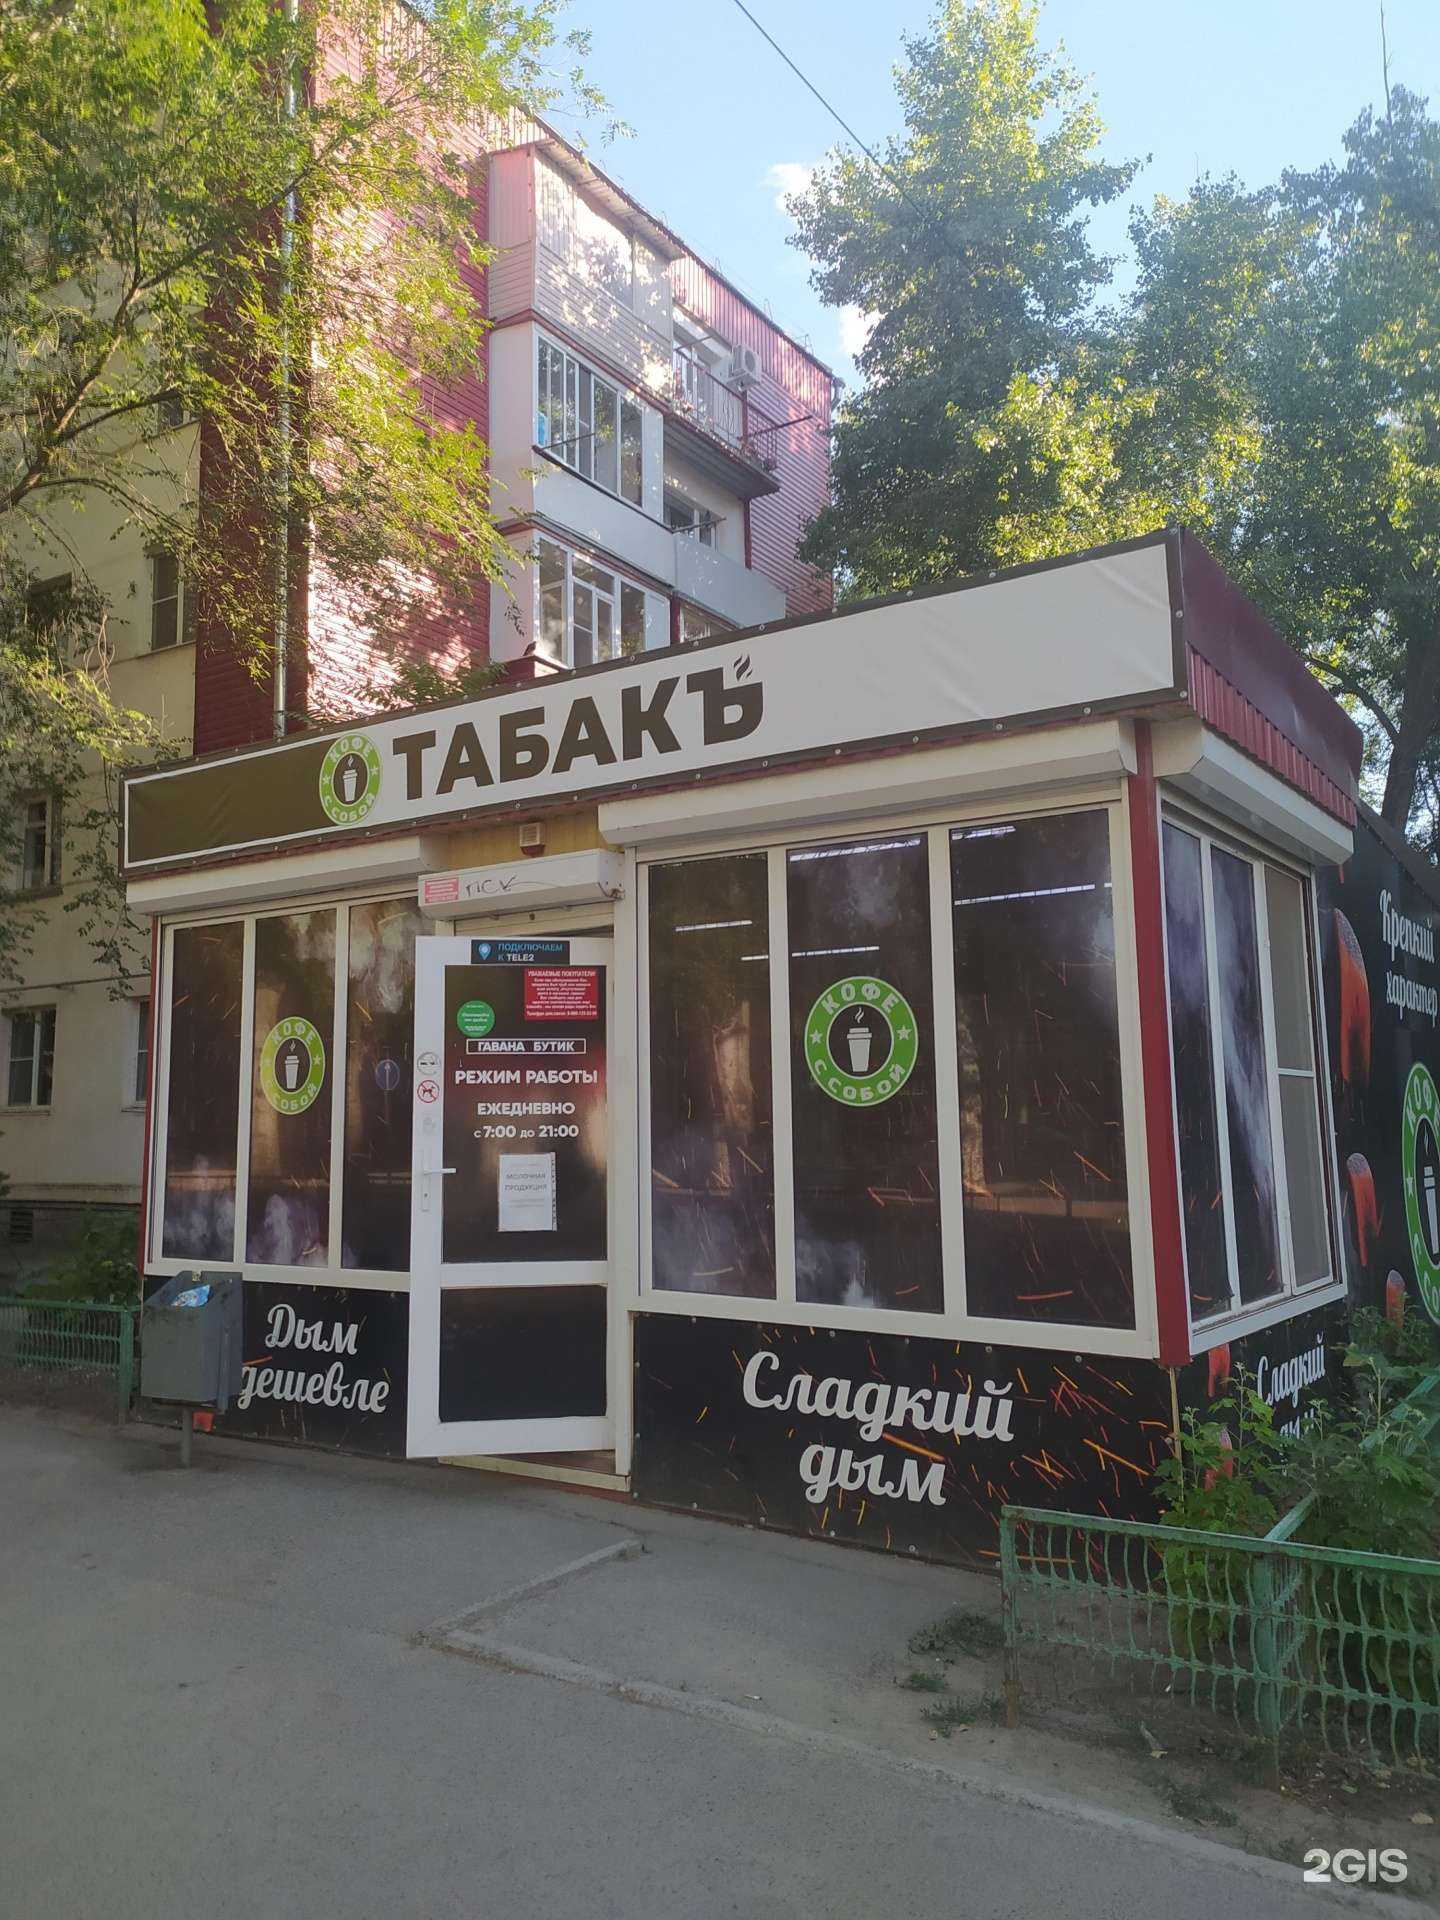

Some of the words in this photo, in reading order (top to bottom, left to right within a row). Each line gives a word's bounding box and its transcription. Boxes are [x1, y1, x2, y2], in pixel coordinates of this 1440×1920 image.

[329, 736, 374, 762] КОФЕ
[392, 666, 765, 801] ТАБАКЪ
[331, 793, 376, 822] СОБОЙ
[1379, 888, 1435, 964] Крепкий
[497, 943, 563, 952] ПОДКЛЮЧАЕМ
[506, 953, 535, 961] TELE2
[820, 982, 900, 1016] КОФЕ
[1385, 970, 1438, 1028] характер
[272, 1021, 317, 1045] КОФЕ
[477, 1041, 525, 1052] ГАВАНА
[533, 1041, 575, 1052] БУТИК
[454, 1070, 521, 1084] РЕЖИМ
[525, 1070, 598, 1084] РАБОТЫ
[814, 1058, 828, 1076] С
[827, 1063, 906, 1101] СОБОЙ
[476, 1102, 576, 1117] ЕЖЕДНЕВНО
[482, 1125, 517, 1138] 7:00
[519, 1129, 536, 1139] до
[538, 1124, 579, 1138] 21:00
[265, 1303, 360, 1354] Дым
[1257, 1330, 1326, 1408] Сладкий
[237, 1361, 391, 1413] дешевле
[742, 1350, 1015, 1443] Сладкий
[799, 1444, 948, 1506] дым
